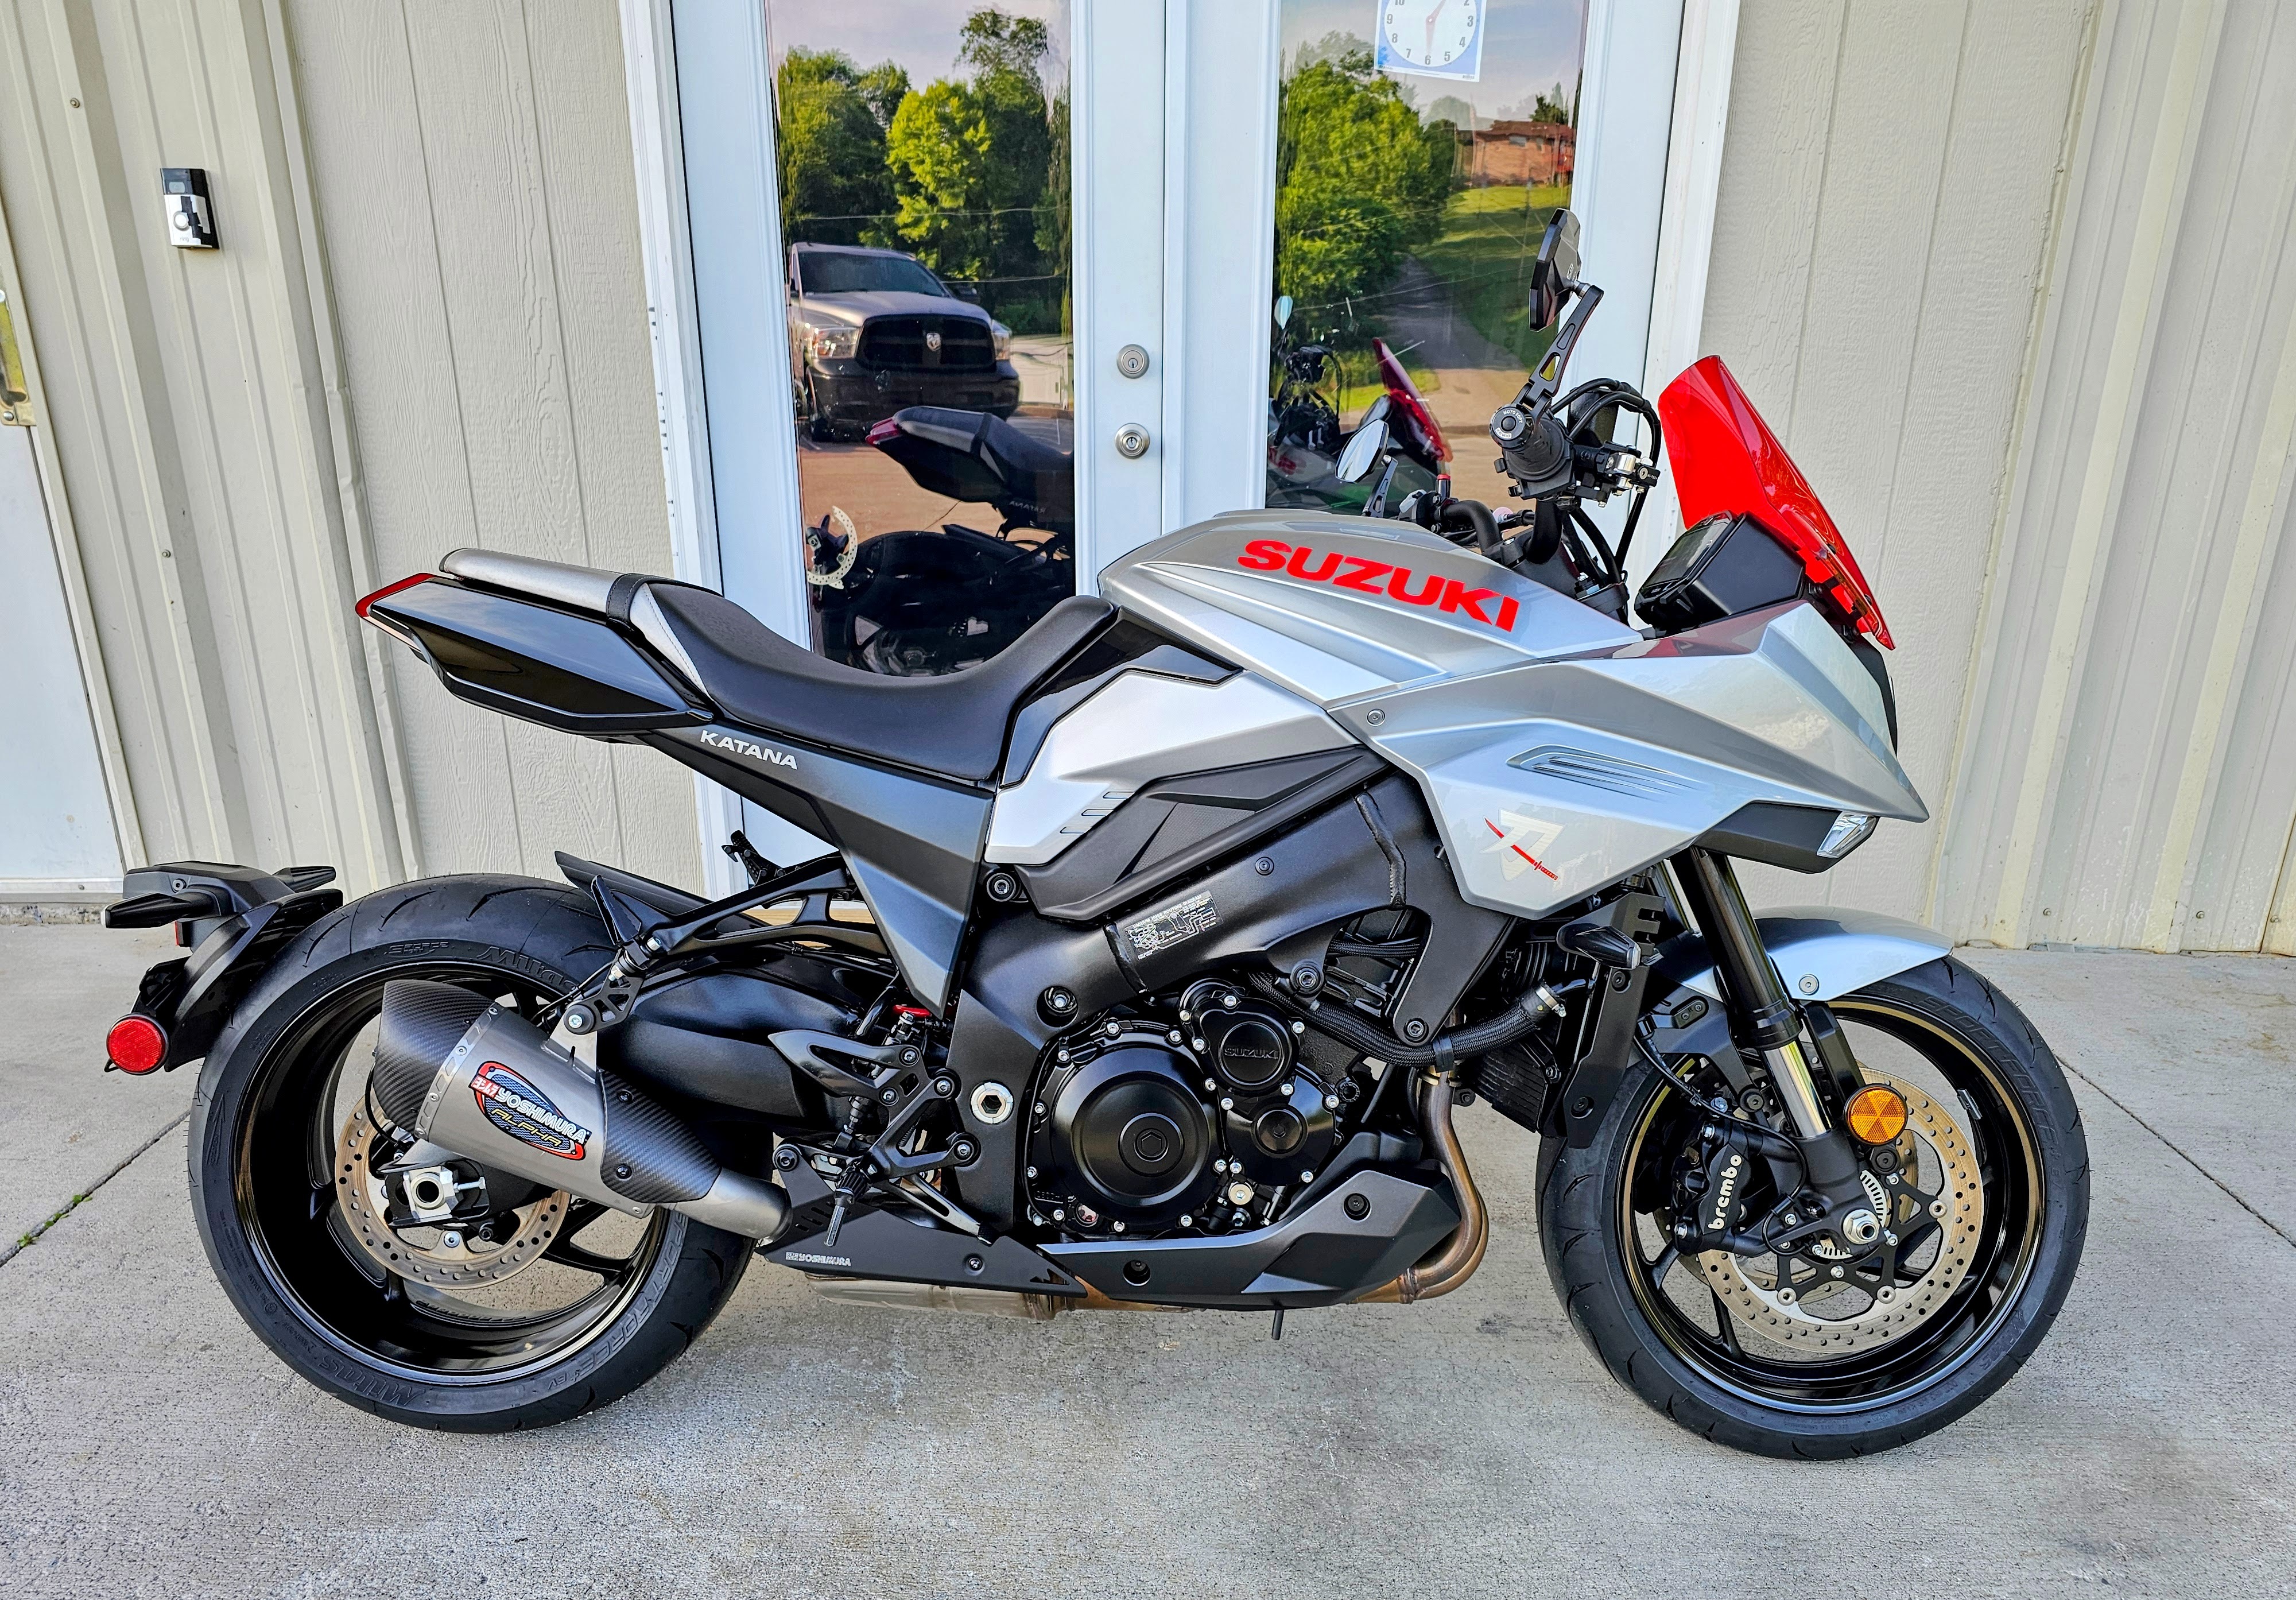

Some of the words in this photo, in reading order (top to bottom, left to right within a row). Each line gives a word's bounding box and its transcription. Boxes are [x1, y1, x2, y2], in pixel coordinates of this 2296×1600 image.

[1386, 13, 1393, 24] 9
[1467, 16, 1473, 27] 3
[1391, 33, 1398, 43] 8
[1459, 37, 1465, 47] 4
[1406, 48, 1411, 58] 7
[1444, 51, 1450, 61] 5
[1425, 55, 1431, 65] 6
[1238, 540, 1520, 633] SUZUKI
[700, 729, 798, 770] KATANA
[1163, 904, 1182, 915] ROUTING
[1224, 1048, 1280, 1060] SUZUKI
[494, 1087, 587, 1145] YOSHIMURA
[491, 1108, 562, 1146] ALPHA
[1708, 1155, 1742, 1230] brembo
[798, 1253, 851, 1266] YOSHIMURA
